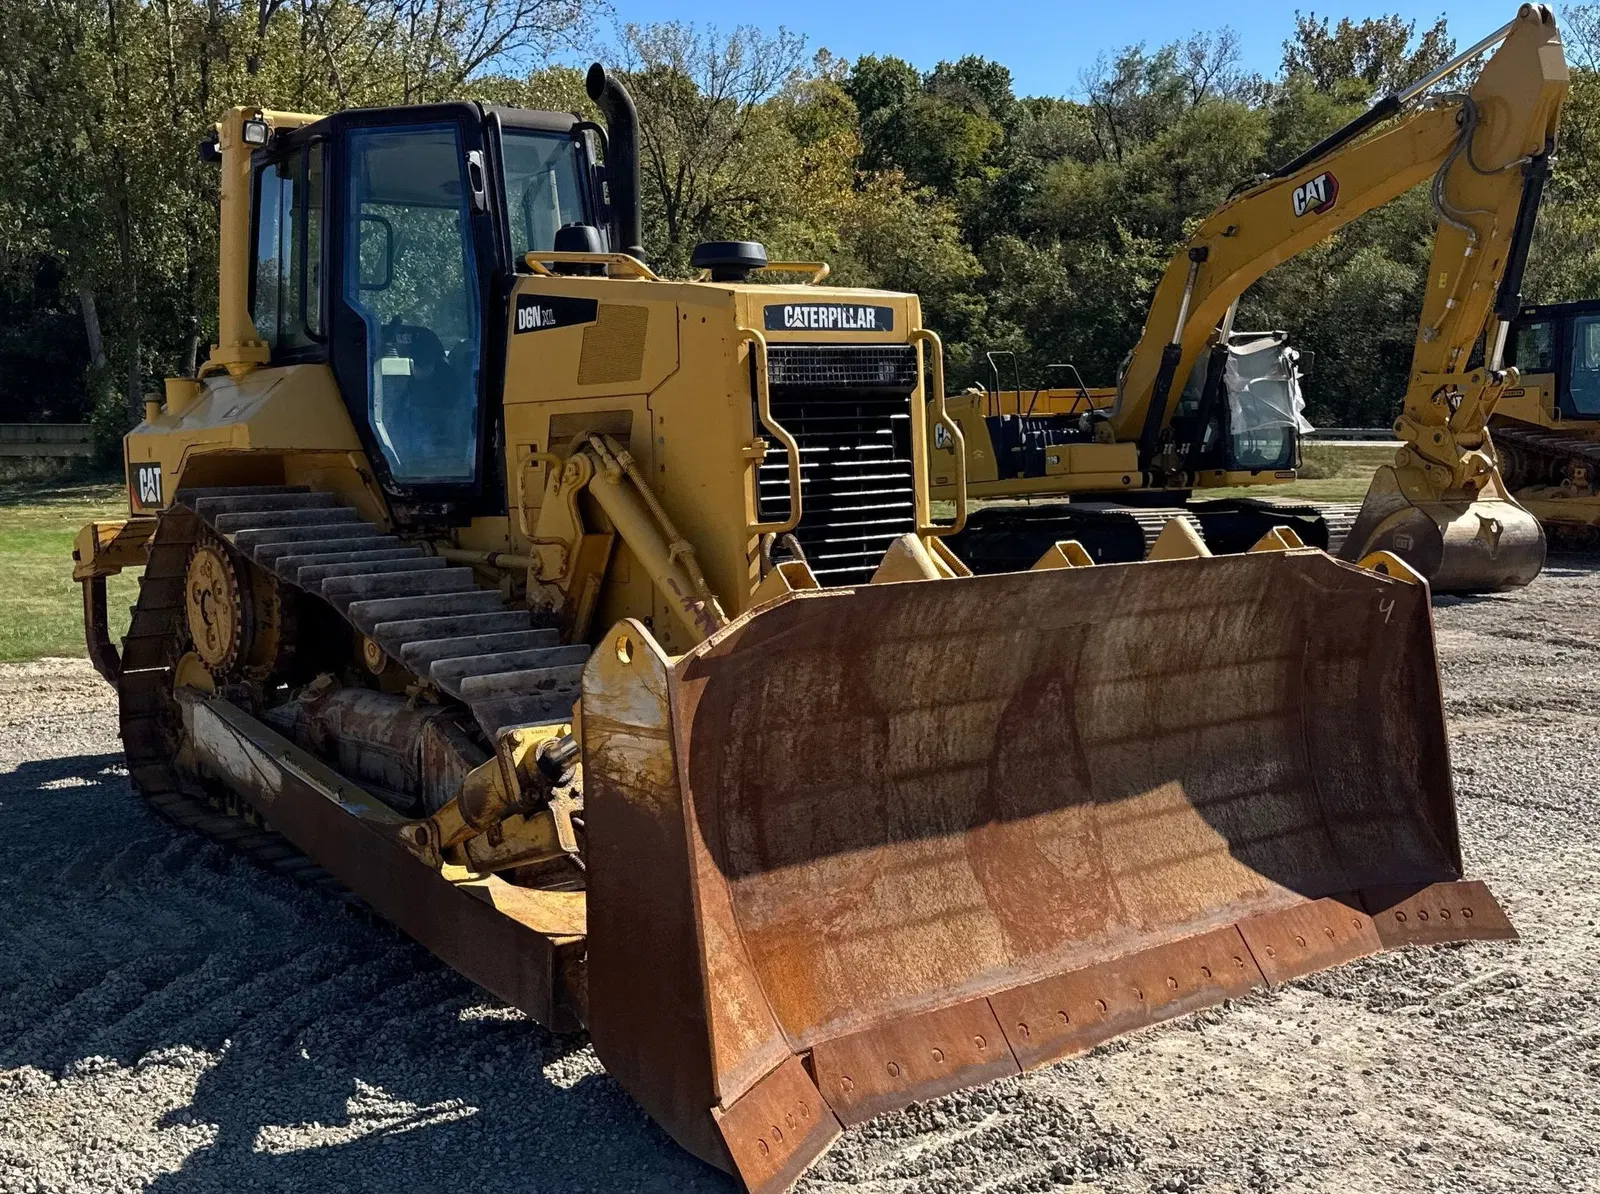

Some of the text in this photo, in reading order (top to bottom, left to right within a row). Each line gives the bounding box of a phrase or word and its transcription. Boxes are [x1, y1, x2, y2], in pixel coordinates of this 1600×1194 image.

[1293, 174, 1326, 216] CAT
[518, 305, 556, 330] D6N XL
[784, 305, 876, 328] CATERPILLAR
[934, 422, 956, 449] CA
[139, 467, 161, 503] CAT
